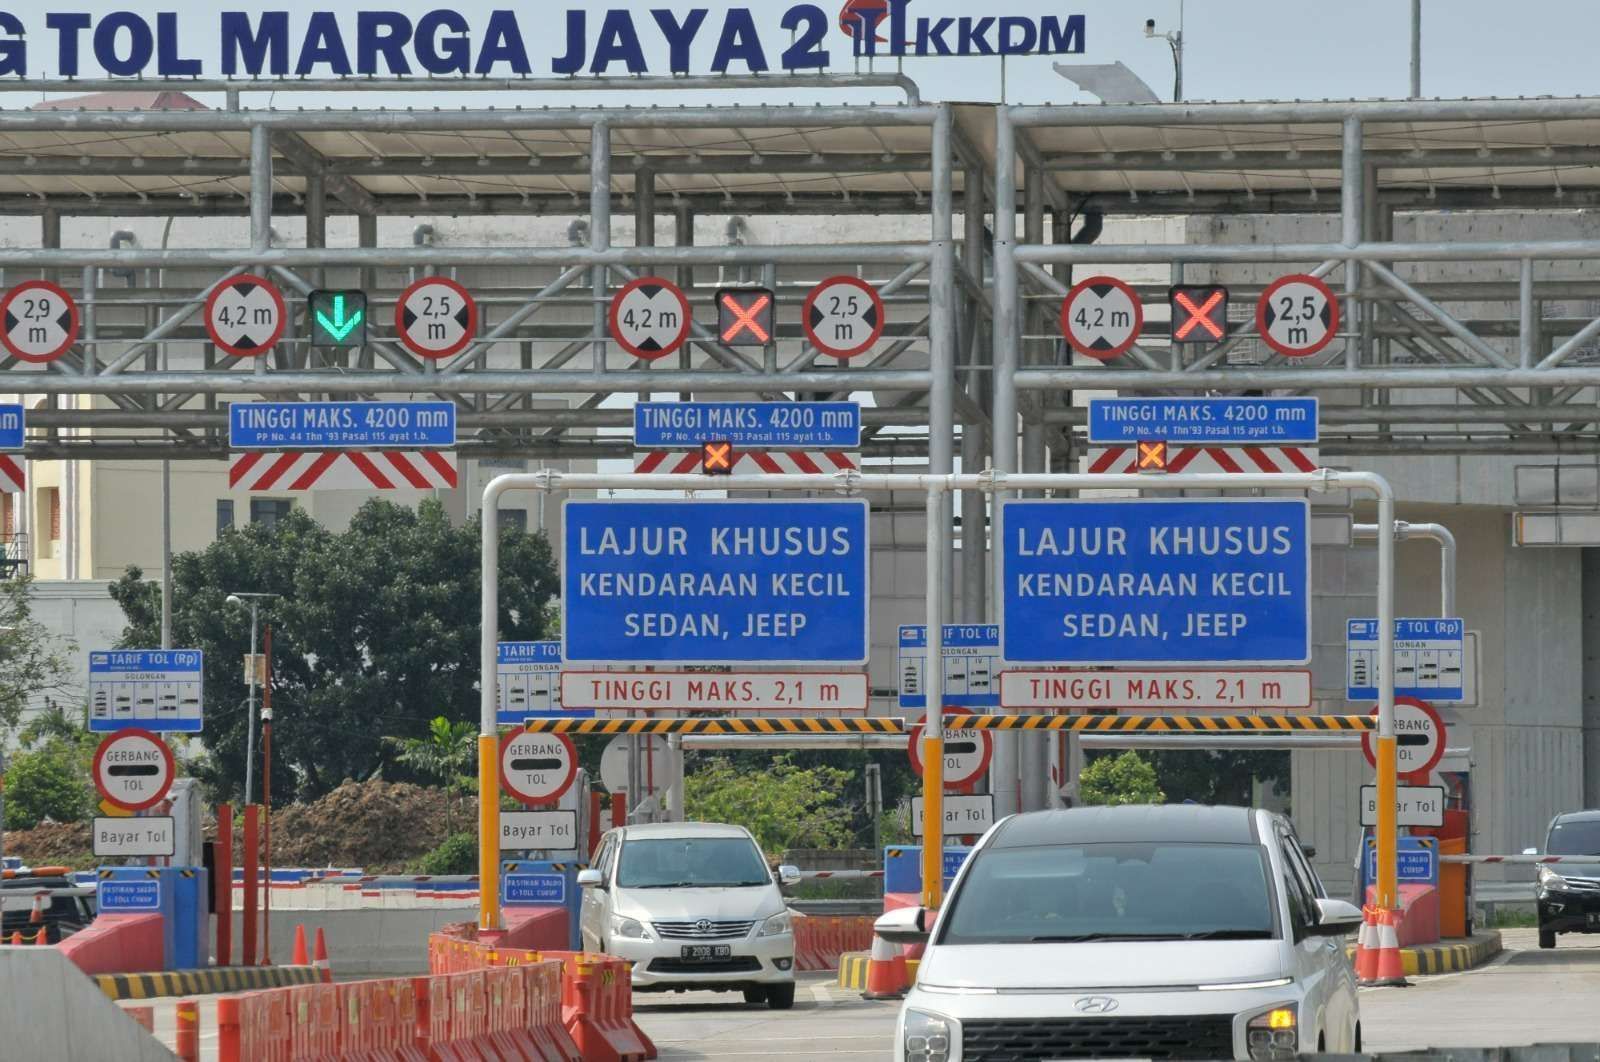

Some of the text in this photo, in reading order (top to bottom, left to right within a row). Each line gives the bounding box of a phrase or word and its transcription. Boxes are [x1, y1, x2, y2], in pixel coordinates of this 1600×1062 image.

[46, 11, 202, 76] TOL
[221, 10, 532, 75] MARGA
[552, 8, 769, 74] JAYA
[780, 4, 830, 70] 2
[916, 15, 1085, 55] KKDM
[23, 299, 50, 323] 2,9
[423, 296, 450, 320] 2,5
[830, 296, 858, 318] 2,5
[1280, 297, 1315, 322] 2,5
[218, 305, 272, 328] 4,2 m
[623, 308, 677, 331] 4,2 m
[1075, 308, 1129, 330] 4,2 m
[28, 327, 46, 343] m
[428, 324, 446, 340] m
[835, 324, 852, 340] m
[1288, 328, 1308, 344] m
[238, 408, 448, 428] TINGGI MAKS. 4200 mm
[643, 408, 852, 428] TINGGI MAKS. 4200 mm
[1102, 405, 1305, 421] TINGGI MAKS. 4200 mm
[256, 432, 268, 440] PP
[272, 432, 286, 440] No.
[290, 432, 301, 440] 44
[306, 432, 322, 440] Thn
[342, 432, 368, 440] Pasal
[372, 432, 385, 440] 115
[388, 432, 409, 442] ayat
[747, 432, 772, 440] Pasal
[776, 432, 790, 440] 115
[793, 432, 813, 442] ayat
[1205, 426, 1229, 434] Pasal
[1233, 426, 1245, 434] 115
[1248, 426, 1268, 436] ayat
[580, 526, 850, 556] LAJUR KHUSUS
[1018, 526, 1292, 556] LAJUR KHUSUS
[580, 572, 850, 597] KENDARAAN KECIL
[1018, 572, 1292, 597] KENDARAAN KECIL
[624, 614, 807, 640] SEDAN, JEEP
[922, 627, 998, 639] TIF TOL (R
[1063, 614, 1247, 640] SEDAN, JEEP
[1408, 622, 1429, 632] TOL
[1435, 621, 1458, 634] (Rp)
[504, 645, 536, 656] TARIF
[110, 653, 198, 666] TARIF TOL (Rp)
[591, 680, 838, 704] TINGGI MAKS. 2,1 m
[1030, 679, 1281, 703] TINGGI MAKS. 2,1 m
[106, 751, 159, 762] GERBANG
[510, 745, 562, 755] GERBANG
[1400, 750, 1413, 760] OL
[124, 780, 144, 790] TOL
[526, 774, 546, 784] TOL
[1416, 800, 1435, 812] Tol
[966, 810, 985, 820] Tol
[101, 831, 166, 845] Bayar Tol
[504, 824, 569, 838] Bayar Tol
